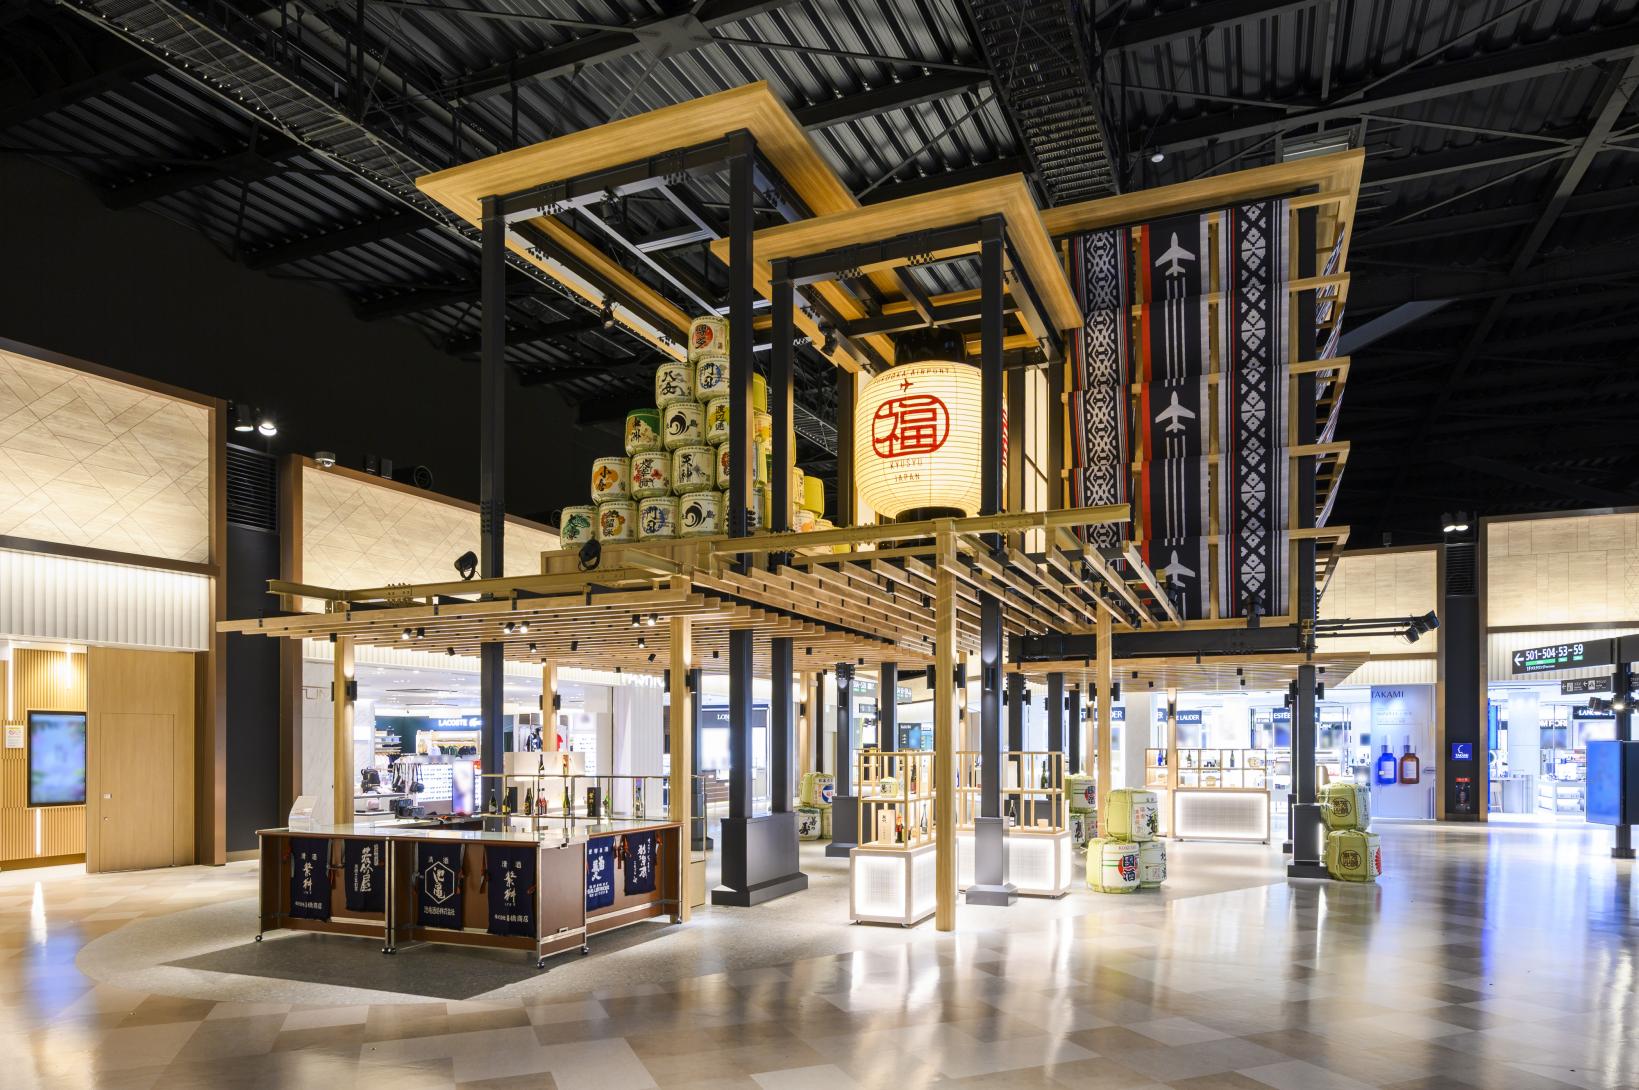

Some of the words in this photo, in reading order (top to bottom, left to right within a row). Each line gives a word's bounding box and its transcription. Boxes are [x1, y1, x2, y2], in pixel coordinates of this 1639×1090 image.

[910, 366, 950, 376] AIRPORT
[661, 370, 677, 396] 八女
[871, 394, 950, 459] 福
[894, 472, 921, 482] JAPAN
[1371, 690, 1404, 698] TAKAMI
[438, 718, 468, 727] LACOSTE
